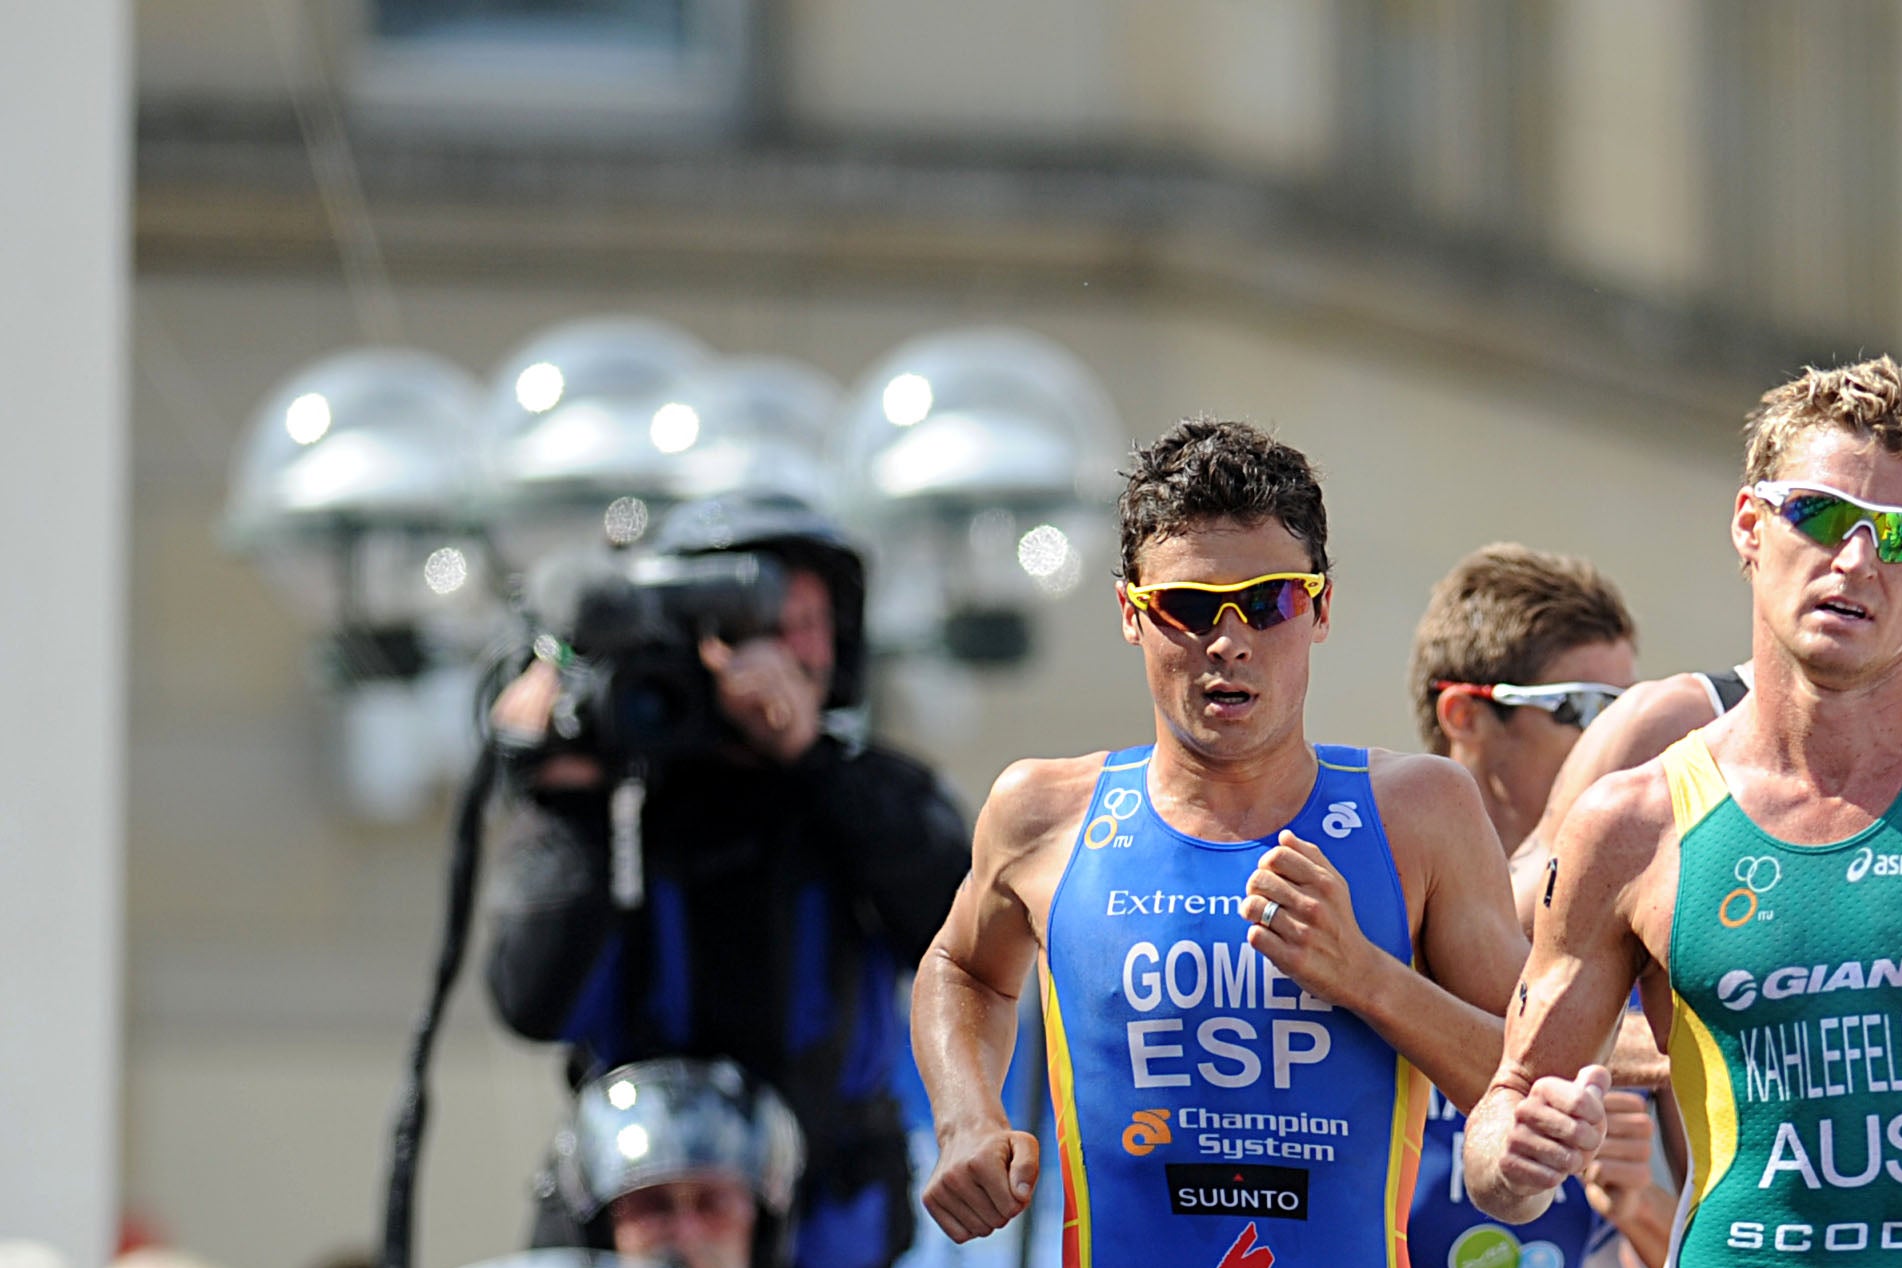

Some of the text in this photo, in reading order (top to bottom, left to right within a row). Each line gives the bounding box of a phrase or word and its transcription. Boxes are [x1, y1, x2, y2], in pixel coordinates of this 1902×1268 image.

[1126, 1016, 1331, 1089] ESP
[1178, 1107, 1349, 1137] Champion
[1198, 1133, 1335, 1162] System
[1178, 1188, 1299, 1211] SUUNTO
